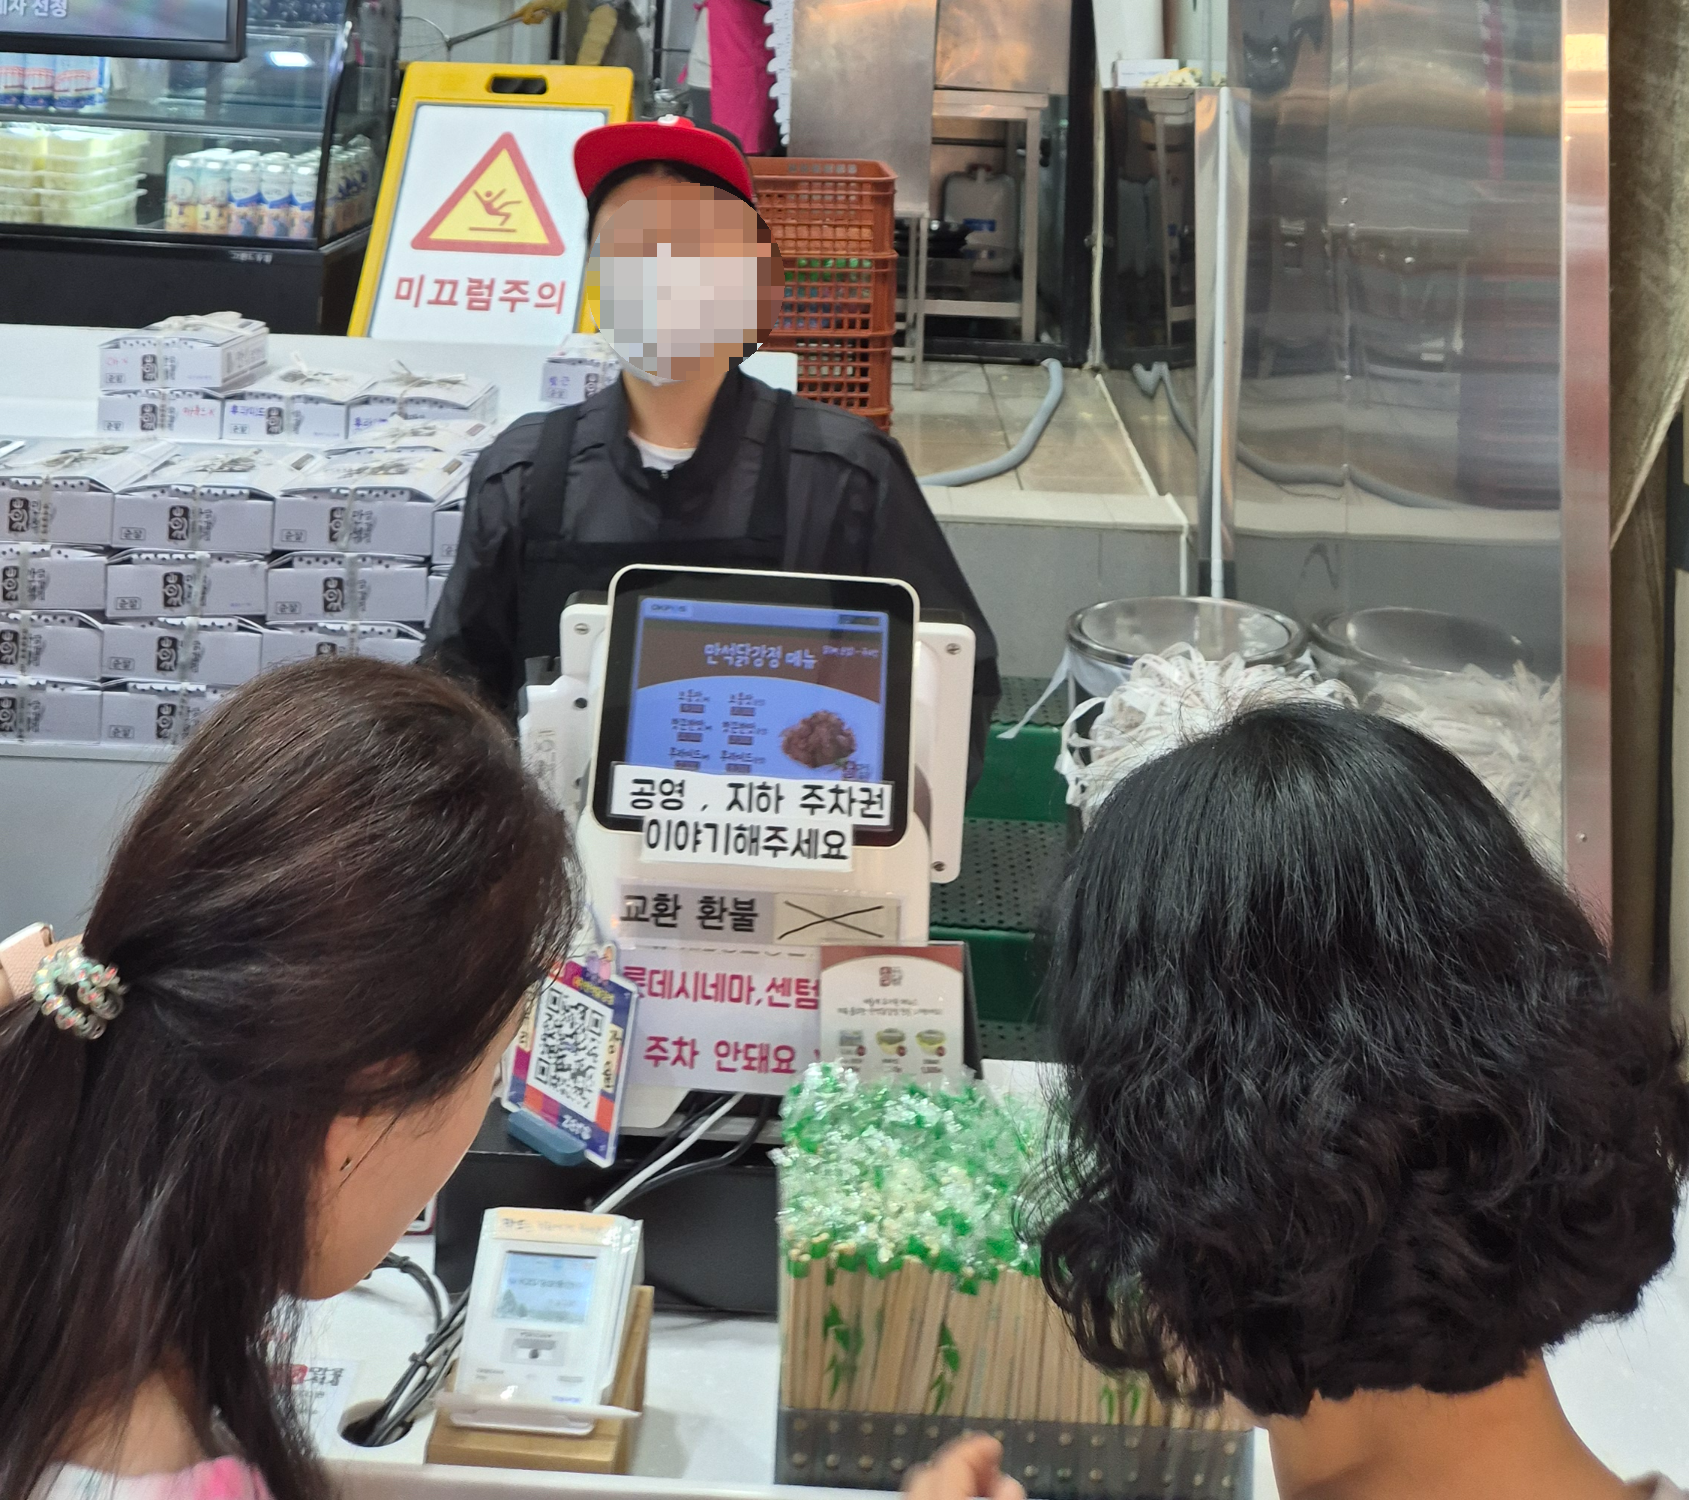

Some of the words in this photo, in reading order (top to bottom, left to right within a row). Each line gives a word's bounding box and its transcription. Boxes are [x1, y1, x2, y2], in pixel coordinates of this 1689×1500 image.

[395, 274, 566, 315] 미끄럼주의
[704, 642, 783, 669] 만석닭강정
[784, 649, 819, 670] 메뉴
[630, 778, 686, 811] 공영
[726, 781, 785, 814] 지하
[799, 784, 885, 819] 주차권
[646, 818, 849, 860] 이야기해주세요
[620, 893, 681, 929] 교환
[696, 895, 758, 933] 환불
[643, 1035, 700, 1070] 주차
[713, 1040, 797, 1074] 안돼요
